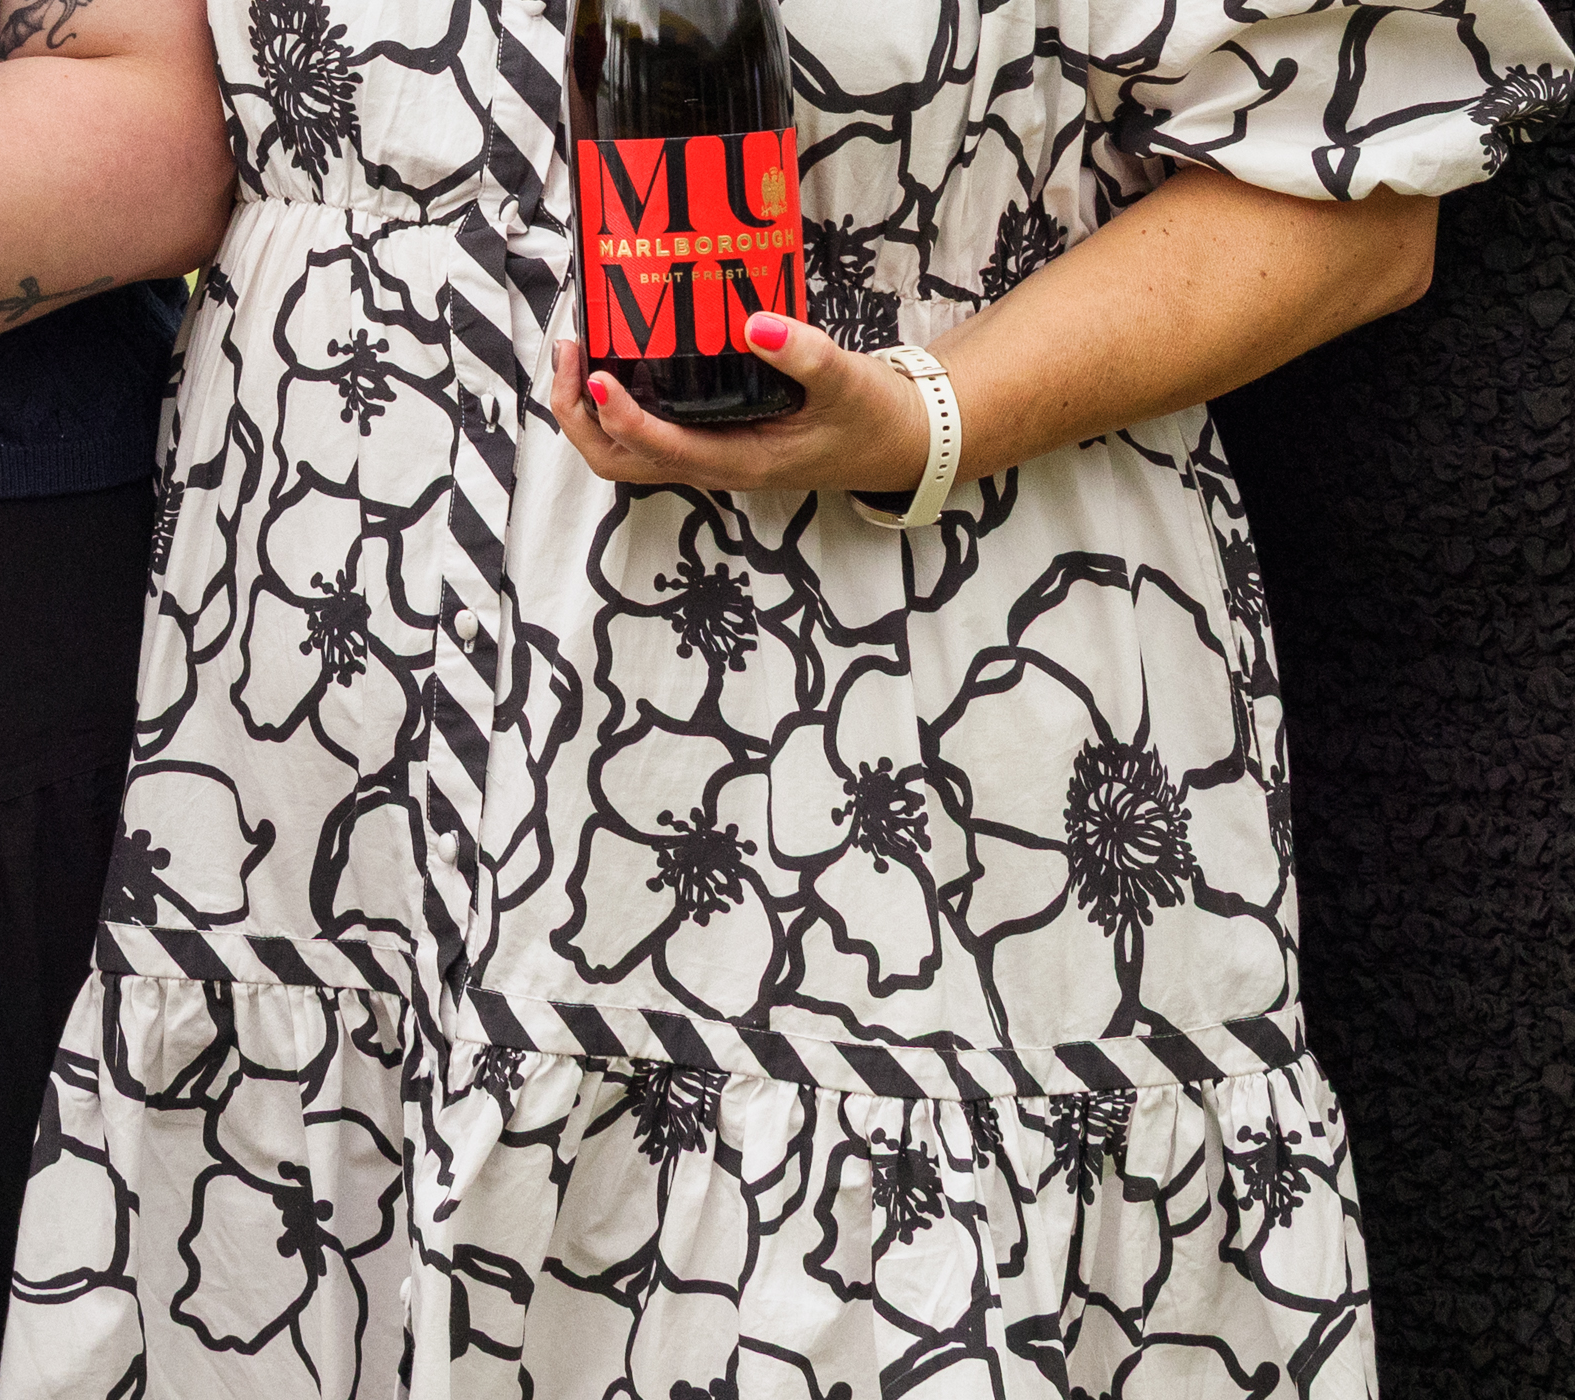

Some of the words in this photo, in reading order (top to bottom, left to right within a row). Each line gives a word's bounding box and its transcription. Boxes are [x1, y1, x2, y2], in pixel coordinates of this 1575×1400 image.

[599, 228, 794, 258] MARLBOROUGH
[639, 271, 684, 284] BRUT
[691, 265, 768, 282] PRESTIGE
